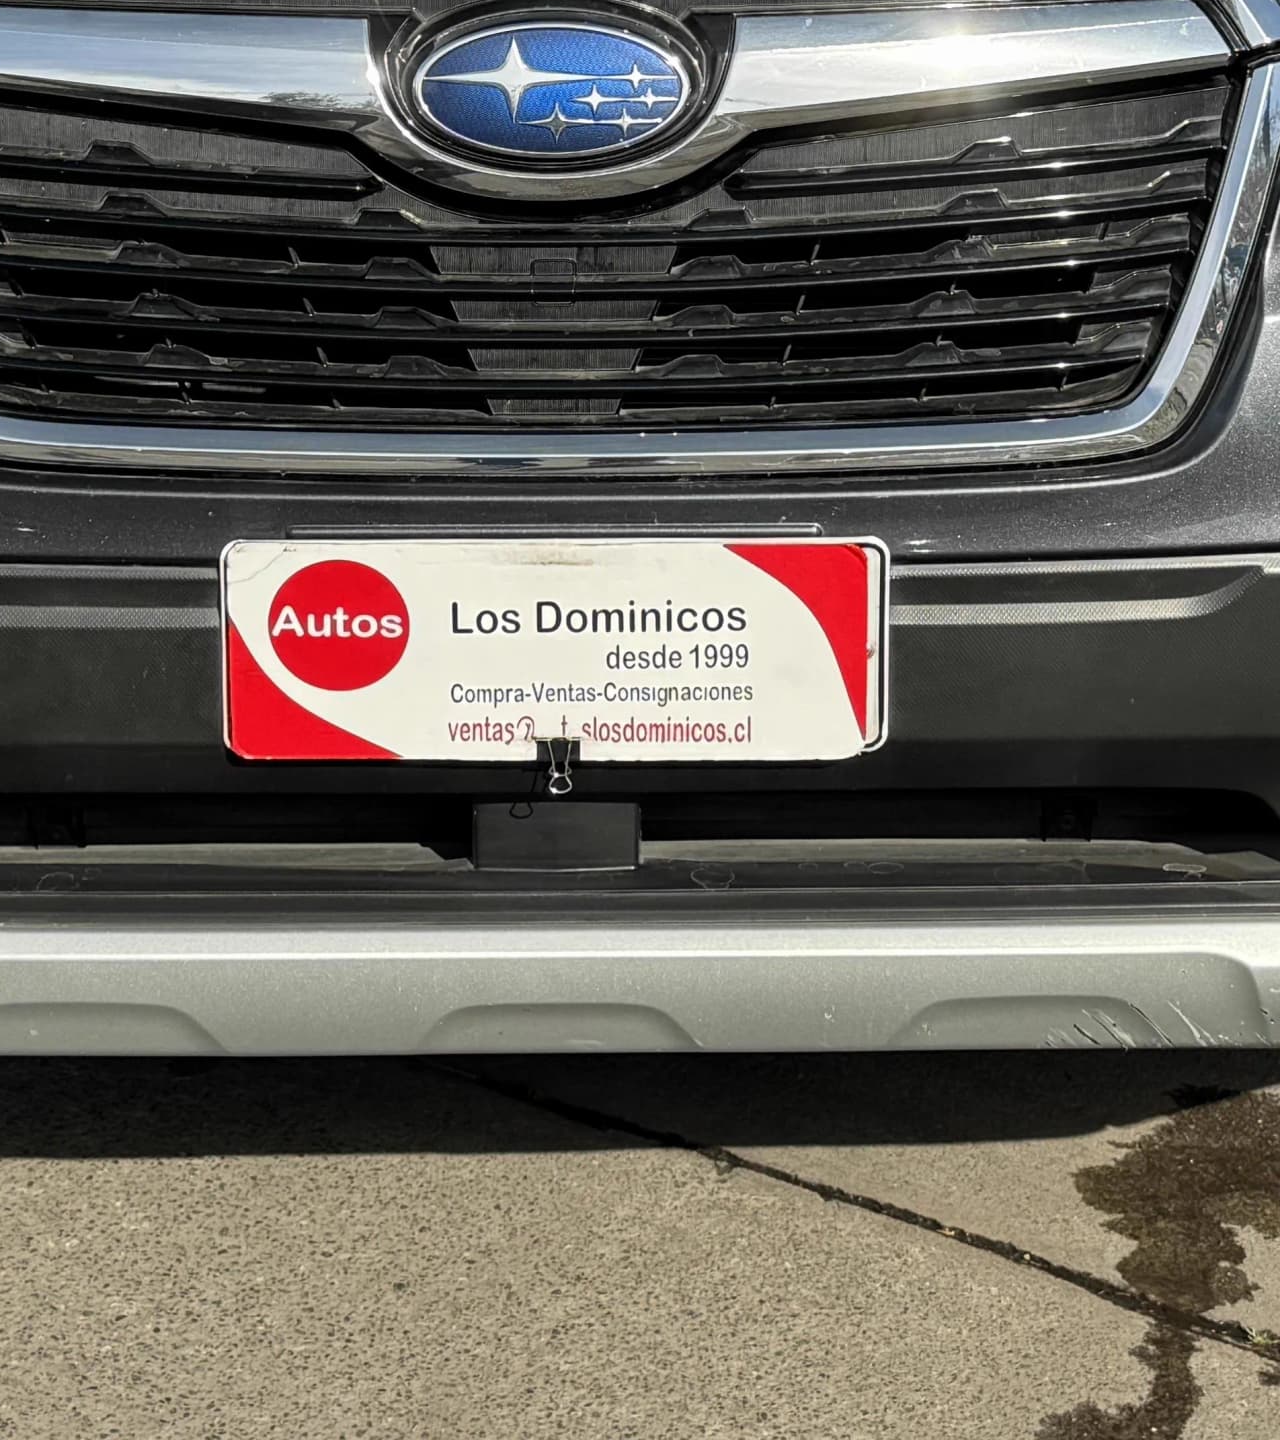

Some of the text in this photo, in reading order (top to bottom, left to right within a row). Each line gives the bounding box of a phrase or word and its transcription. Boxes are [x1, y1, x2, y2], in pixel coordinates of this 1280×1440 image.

[271, 599, 747, 639] Autos Los Dominicos
[605, 643, 749, 669] desde 1999
[450, 682, 753, 708] Compra-Ventas-Consignaciones
